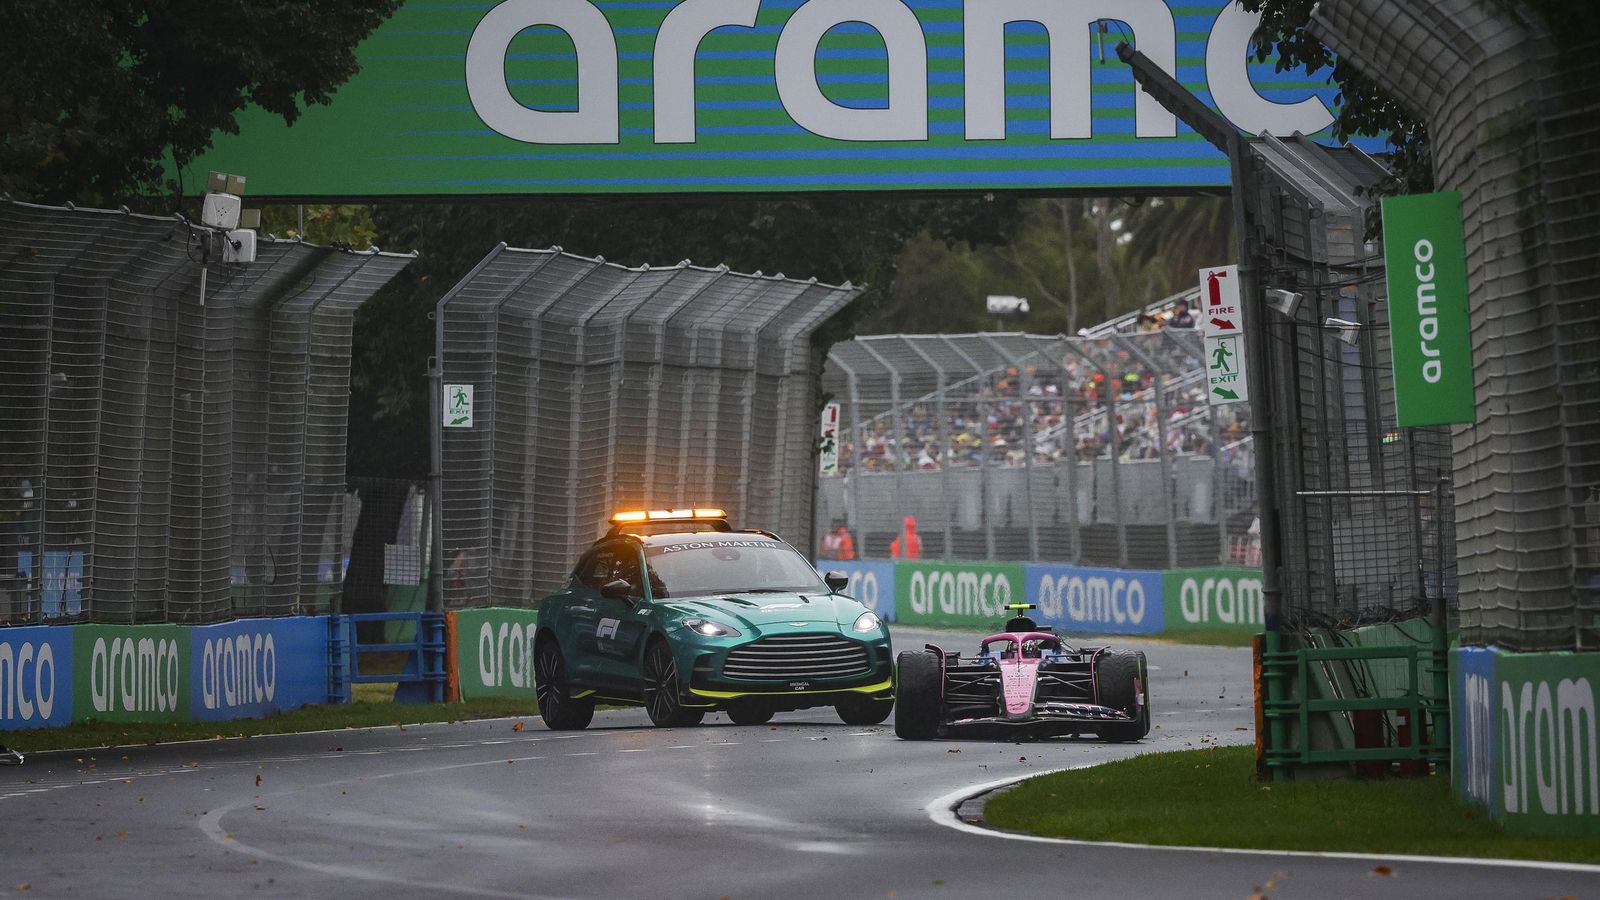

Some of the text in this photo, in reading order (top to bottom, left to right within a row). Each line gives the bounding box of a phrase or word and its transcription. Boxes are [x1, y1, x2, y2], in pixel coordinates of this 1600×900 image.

[1208, 306, 1235, 316] FIRE
[1414, 239, 1442, 384] aramco
[1210, 375, 1238, 385] EXIT
[663, 541, 777, 553] ASTON MARTIN
[840, 570, 878, 610] co
[909, 570, 1012, 617] aramco
[1038, 574, 1145, 624] aramco
[1181, 577, 1265, 624] aram
[596, 617, 620, 640] F1
[91, 637, 179, 712] aramco
[202, 633, 275, 709] aramco
